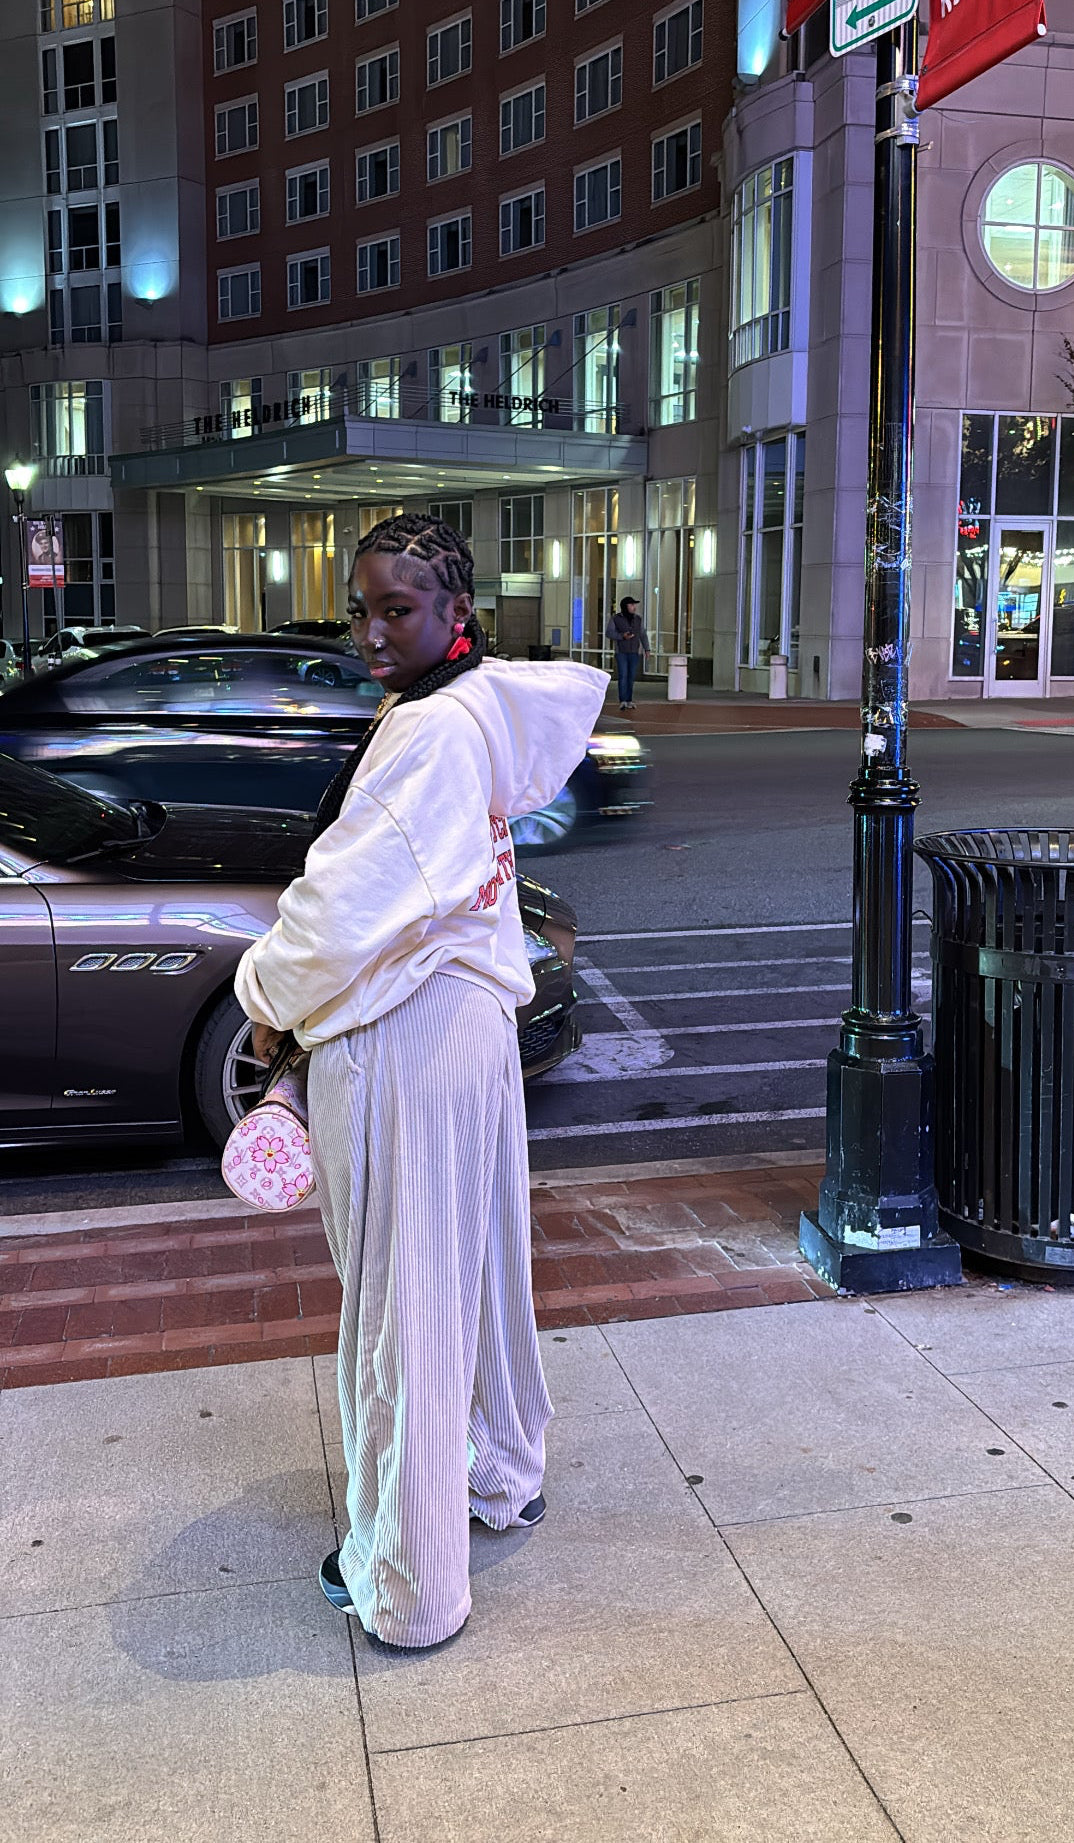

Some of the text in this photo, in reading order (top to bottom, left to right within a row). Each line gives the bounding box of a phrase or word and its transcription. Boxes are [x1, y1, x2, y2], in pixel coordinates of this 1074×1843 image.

[193, 395, 311, 436] THE HELDRICH
[449, 391, 560, 414] THE HELDRICH
